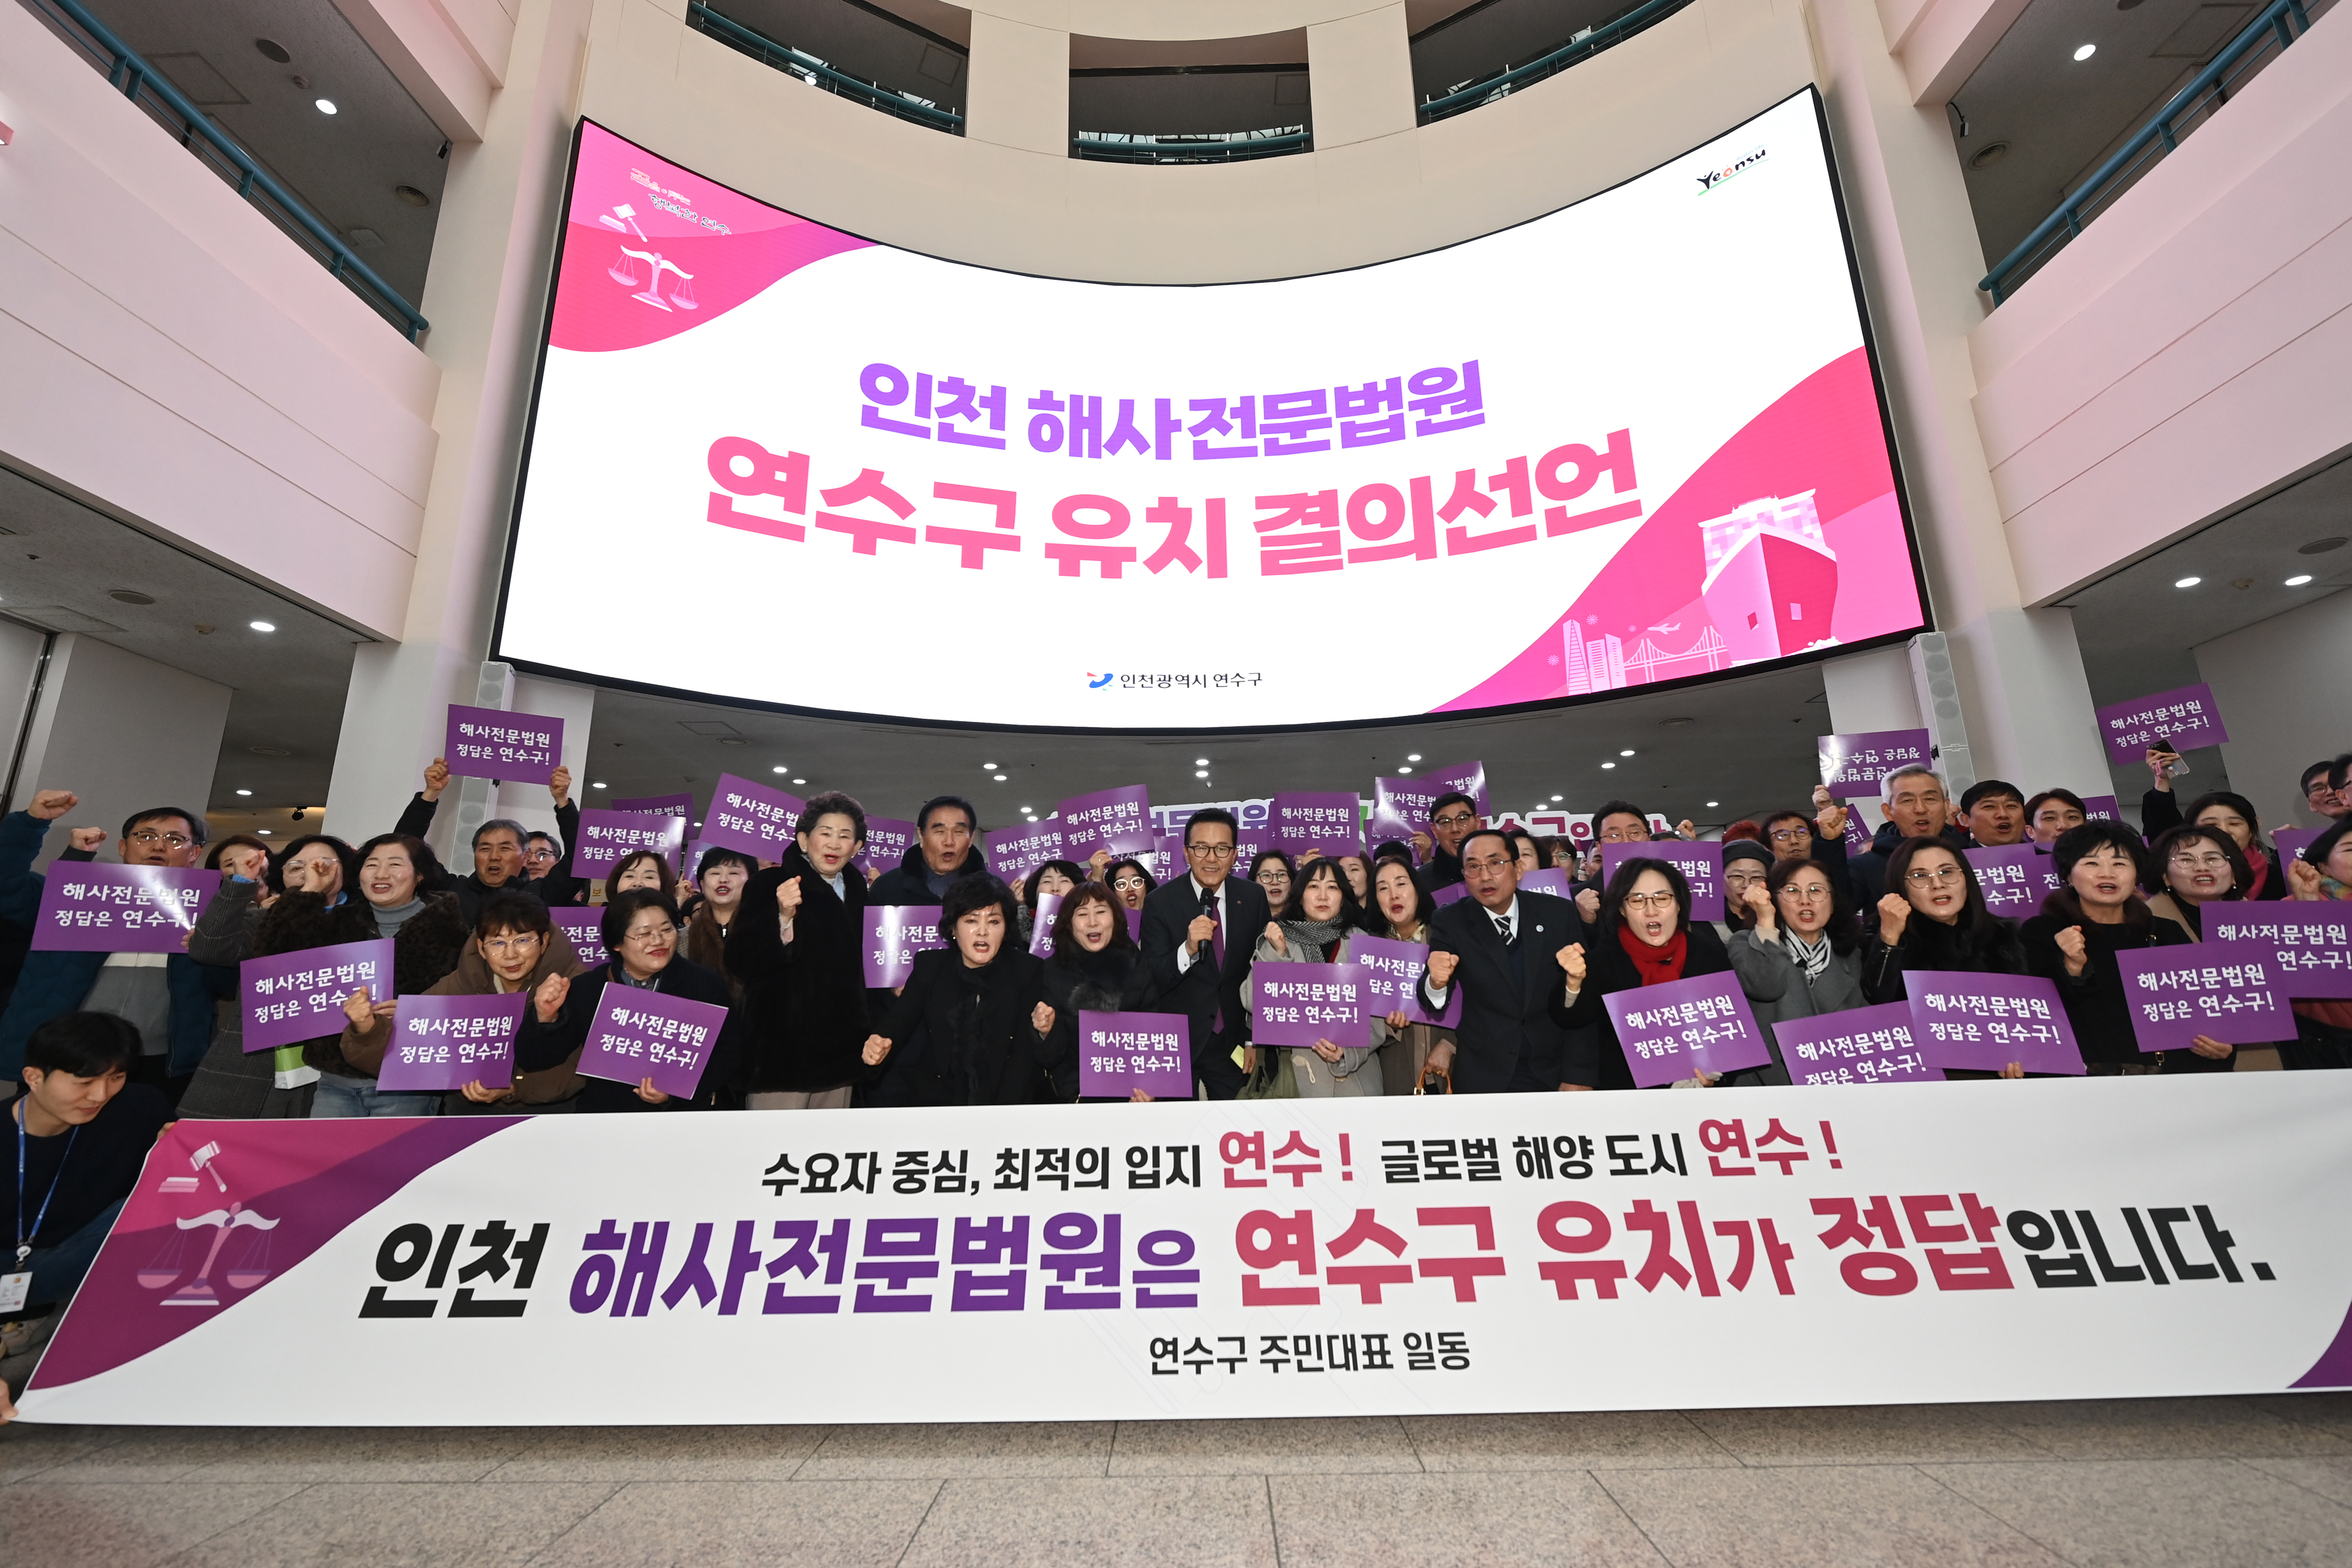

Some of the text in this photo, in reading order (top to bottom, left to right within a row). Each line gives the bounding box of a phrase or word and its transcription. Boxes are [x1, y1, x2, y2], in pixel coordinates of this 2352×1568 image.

[1697, 149, 1765, 189] Yeonsu
[648, 194, 732, 235] 행복한 연수
[859, 359, 1486, 461] 인천 해사전문법원
[706, 427, 1643, 579] 연수구 유치 결의선언
[1120, 672, 1263, 689] 인천광역시 연수구
[2110, 699, 2203, 731] 해사전문법원
[459, 722, 550, 748] 해사전문법원
[2115, 715, 2210, 748] 정답은 연수구!
[456, 744, 550, 766] 정답은 연수구!
[726, 792, 799, 828] 해사전문법
[1384, 791, 1436, 808] 해사전문법
[1067, 801, 1139, 827] 해사전문법원
[1281, 808, 1349, 822] 해사전문법원
[587, 826, 668, 847] 해사전문법원
[717, 813, 796, 842] 정답은 연수
[866, 830, 906, 846] 전문법원
[1069, 828, 1096, 846] 정답은
[1099, 818, 1143, 838] 연수구!
[1281, 826, 1306, 838] 정답은
[1309, 825, 1350, 839] 연수구!
[583, 847, 615, 860] 정답은
[996, 831, 1063, 855] 해사전문법원
[998, 848, 1063, 872] 정답은 연수구
[1987, 887, 2033, 906] 수구!
[55, 910, 113, 927] 정답은
[2217, 924, 2347, 946] 해사전문법원
[1360, 953, 1426, 979] 해사전문
[2276, 950, 2352, 971] 연수구!
[255, 960, 376, 995] 해사전문법원
[1369, 979, 1394, 996] 답은
[2137, 963, 2267, 991] 해사전문법원
[1263, 981, 1357, 1003] 해사전문법원
[254, 999, 302, 1024] 정답은
[1262, 1005, 1358, 1024] 정답은 연수구!
[1625, 995, 1736, 1030] 해사전문법원
[1924, 993, 2051, 1020] 해사전문법원
[2142, 991, 2275, 1022] 정답은 연수구!
[408, 1016, 513, 1038] 해사전문법원
[610, 1007, 708, 1047] 해사전문법원
[1634, 1020, 1748, 1059] 정답은 연수구!
[1929, 1022, 2062, 1045] 정답은 연수구!
[399, 1041, 509, 1064] 정답은 연수구!
[600, 1034, 699, 1070] 정답은 연수구!
[1091, 1030, 1179, 1051] 해사전문법원
[1796, 1025, 1915, 1061] 해사전문법원
[1090, 1055, 1181, 1074] 정답은 연수구!
[1857, 1052, 1927, 1083] 연수구!
[762, 1152, 882, 1196] 수요자
[892, 1150, 979, 1196] 중심,
[994, 1147, 1109, 1191] 최적의
[1126, 1145, 1201, 1189] 입지
[1381, 1138, 1502, 1183] 글로벌
[1512, 1135, 1594, 1180] 해양
[1605, 1133, 1688, 1176] 도시
[359, 1193, 2276, 1318] 인천 해사전문법원은 연수구 유치가 정답입니다.
[1150, 1332, 1470, 1375] 연수구 주민대표 일동
